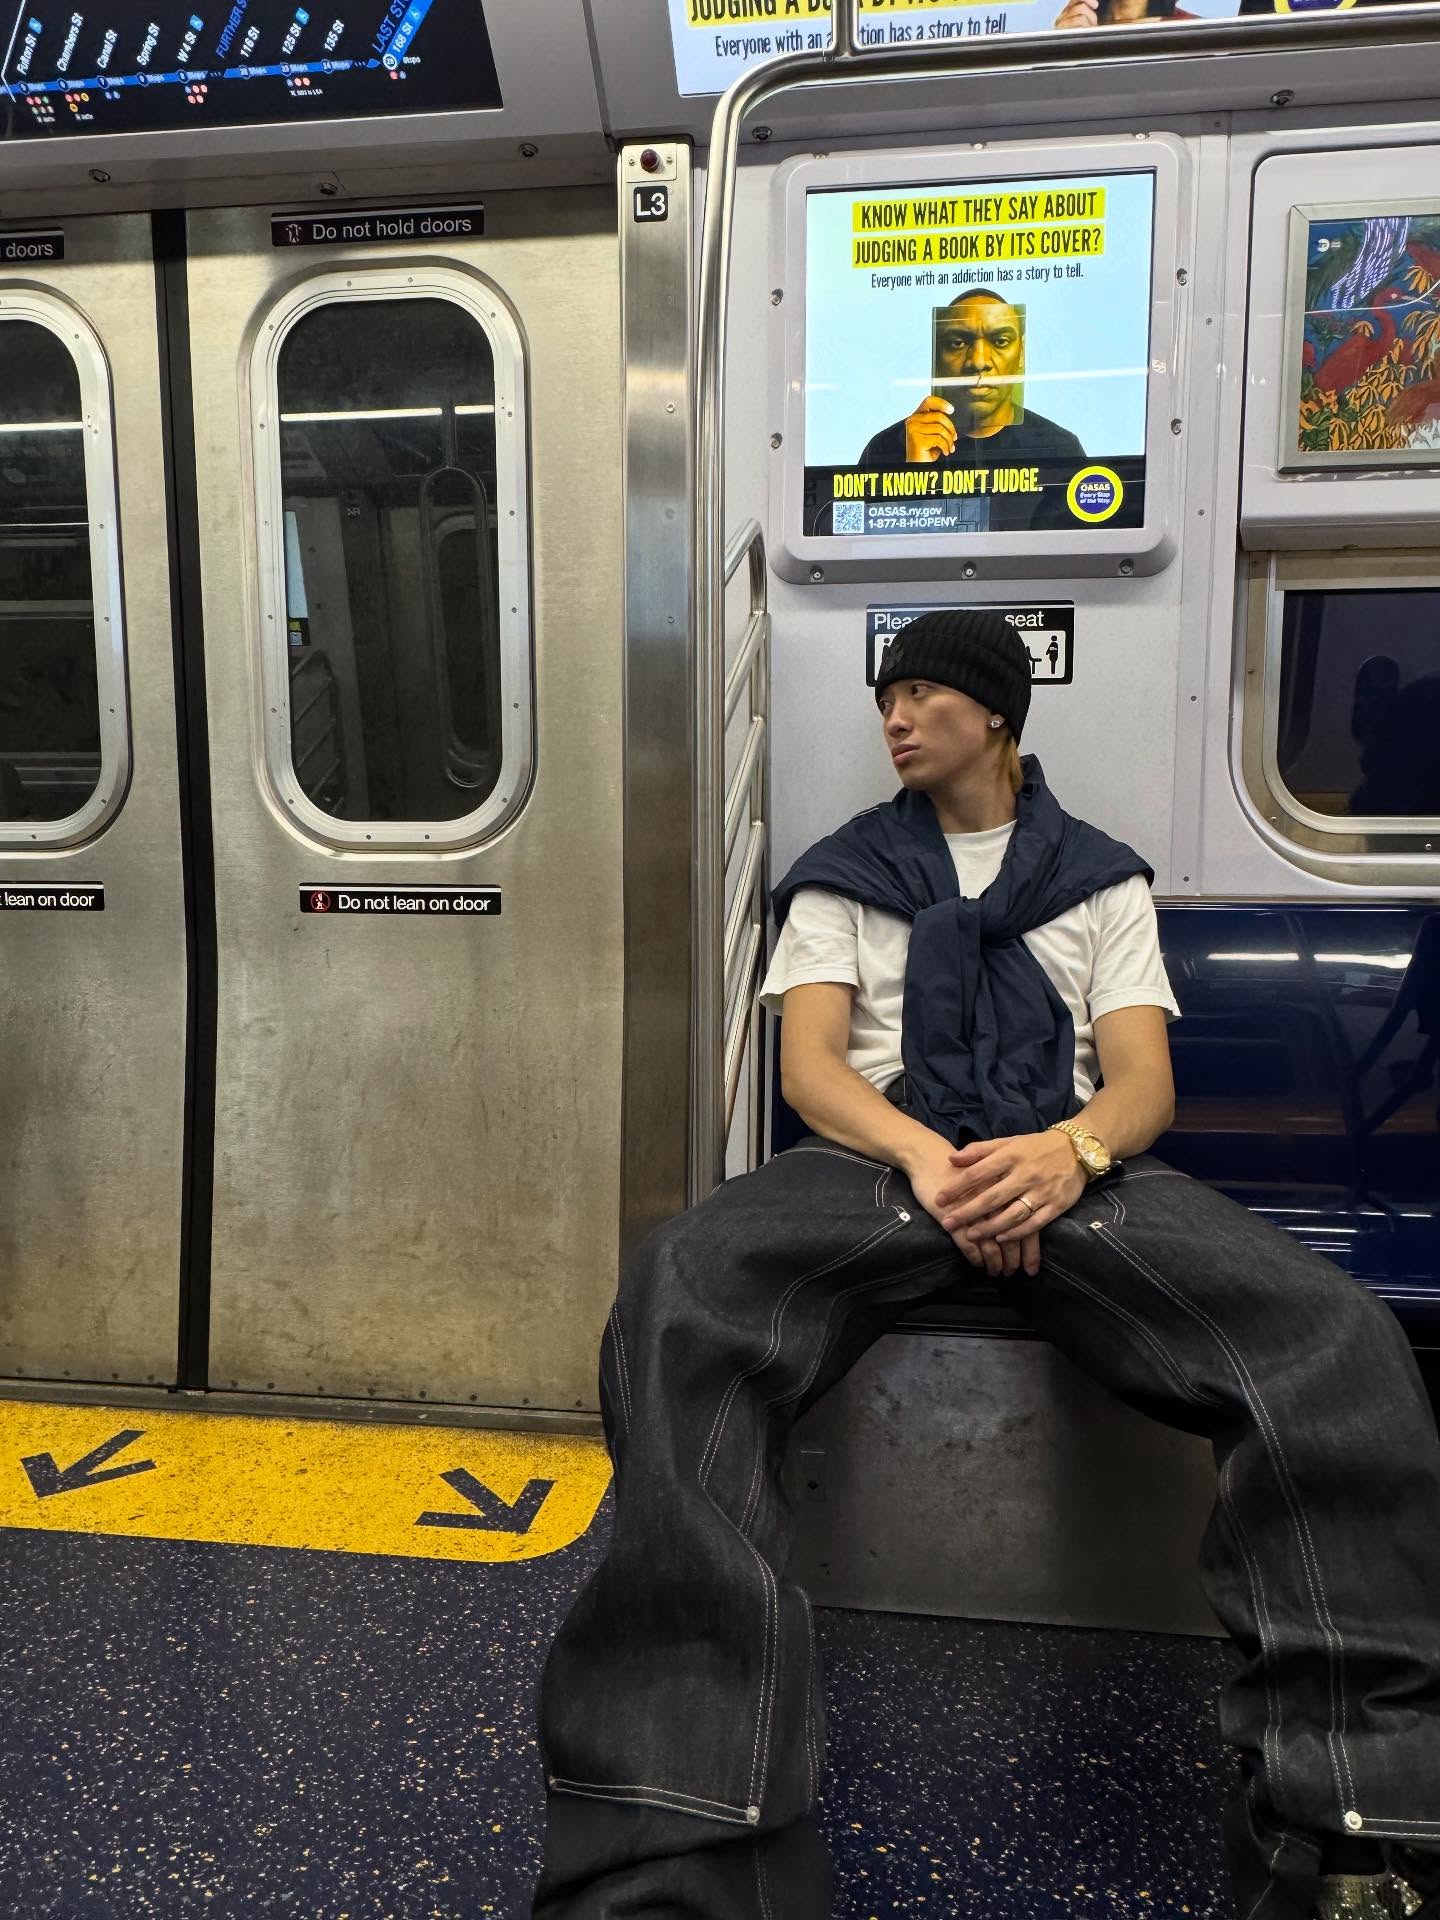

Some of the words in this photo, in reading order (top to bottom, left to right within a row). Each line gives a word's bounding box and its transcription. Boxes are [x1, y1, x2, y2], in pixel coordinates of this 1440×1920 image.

[25, 34, 37, 47] St
[57, 25, 79, 71] Chambers
[71, 12, 84, 26] St
[136, 34, 157, 66] Spring
[148, 22, 160, 37] St
[184, 31, 197, 45] St
[216, 6, 243, 59] FURTHER
[240, 37, 255, 58] 116
[248, 26, 260, 40] St
[282, 34, 296, 55] 125
[290, 22, 302, 37] St
[324, 31, 338, 52] 135
[332, 19, 344, 34] St
[371, 14, 396, 53] LAST
[392, 34, 407, 52] 168
[402, 22, 413, 36] St
[715, 35, 770, 60] Everyone
[775, 29, 803, 52] with
[807, 33, 822, 49] an
[890, 21, 912, 43] has
[917, 25, 924, 40] a
[928, 19, 963, 39] story
[968, 17, 981, 36] to
[97, 40, 113, 68] Canal
[105, 29, 118, 43] St
[177, 49, 189, 62] W
[182, 43, 191, 52] 4
[636, 192, 666, 216] L3
[862, 203, 907, 229] KNOW
[913, 200, 958, 226] WHAT
[963, 197, 1003, 223] THEY
[1008, 195, 1038, 221] SAY
[1044, 192, 1097, 218] ABOUT
[312, 224, 337, 240] Do
[343, 221, 371, 239] not
[376, 218, 414, 236] hold
[420, 217, 472, 235] doors
[6, 242, 53, 258] doors
[855, 238, 917, 264] JUDGING
[922, 238, 933, 261] A
[939, 235, 979, 260] BOOK
[985, 233, 1005, 257] BY
[1011, 232, 1035, 256] ITS
[1041, 228, 1101, 254] COVER?
[871, 273, 912, 291] Everyone
[915, 270, 935, 286] with
[938, 273, 948, 285] an
[952, 268, 994, 284] addiction
[997, 267, 1013, 282] has
[1017, 269, 1022, 281] a
[1025, 266, 1050, 283] story
[1054, 265, 1063, 279] to
[1066, 263, 1084, 278] tell.
[833, 473, 878, 498] DON'T
[882, 471, 938, 496] KNOW?
[943, 469, 989, 495] DON'T
[992, 467, 1043, 493] JUDGE.
[868, 506, 942, 518] OASAS.ny.gov
[868, 516, 957, 529] 1-877-8-HOPENY
[874, 613, 918, 630] Plea
[1004, 610, 1045, 627] seat
[4, 891, 35, 906] lean
[37, 895, 57, 907] on
[60, 892, 95, 907] door
[338, 894, 361, 910] Do
[364, 896, 390, 910] not
[393, 895, 425, 911] lean
[429, 899, 450, 911] on
[452, 896, 491, 911] door
